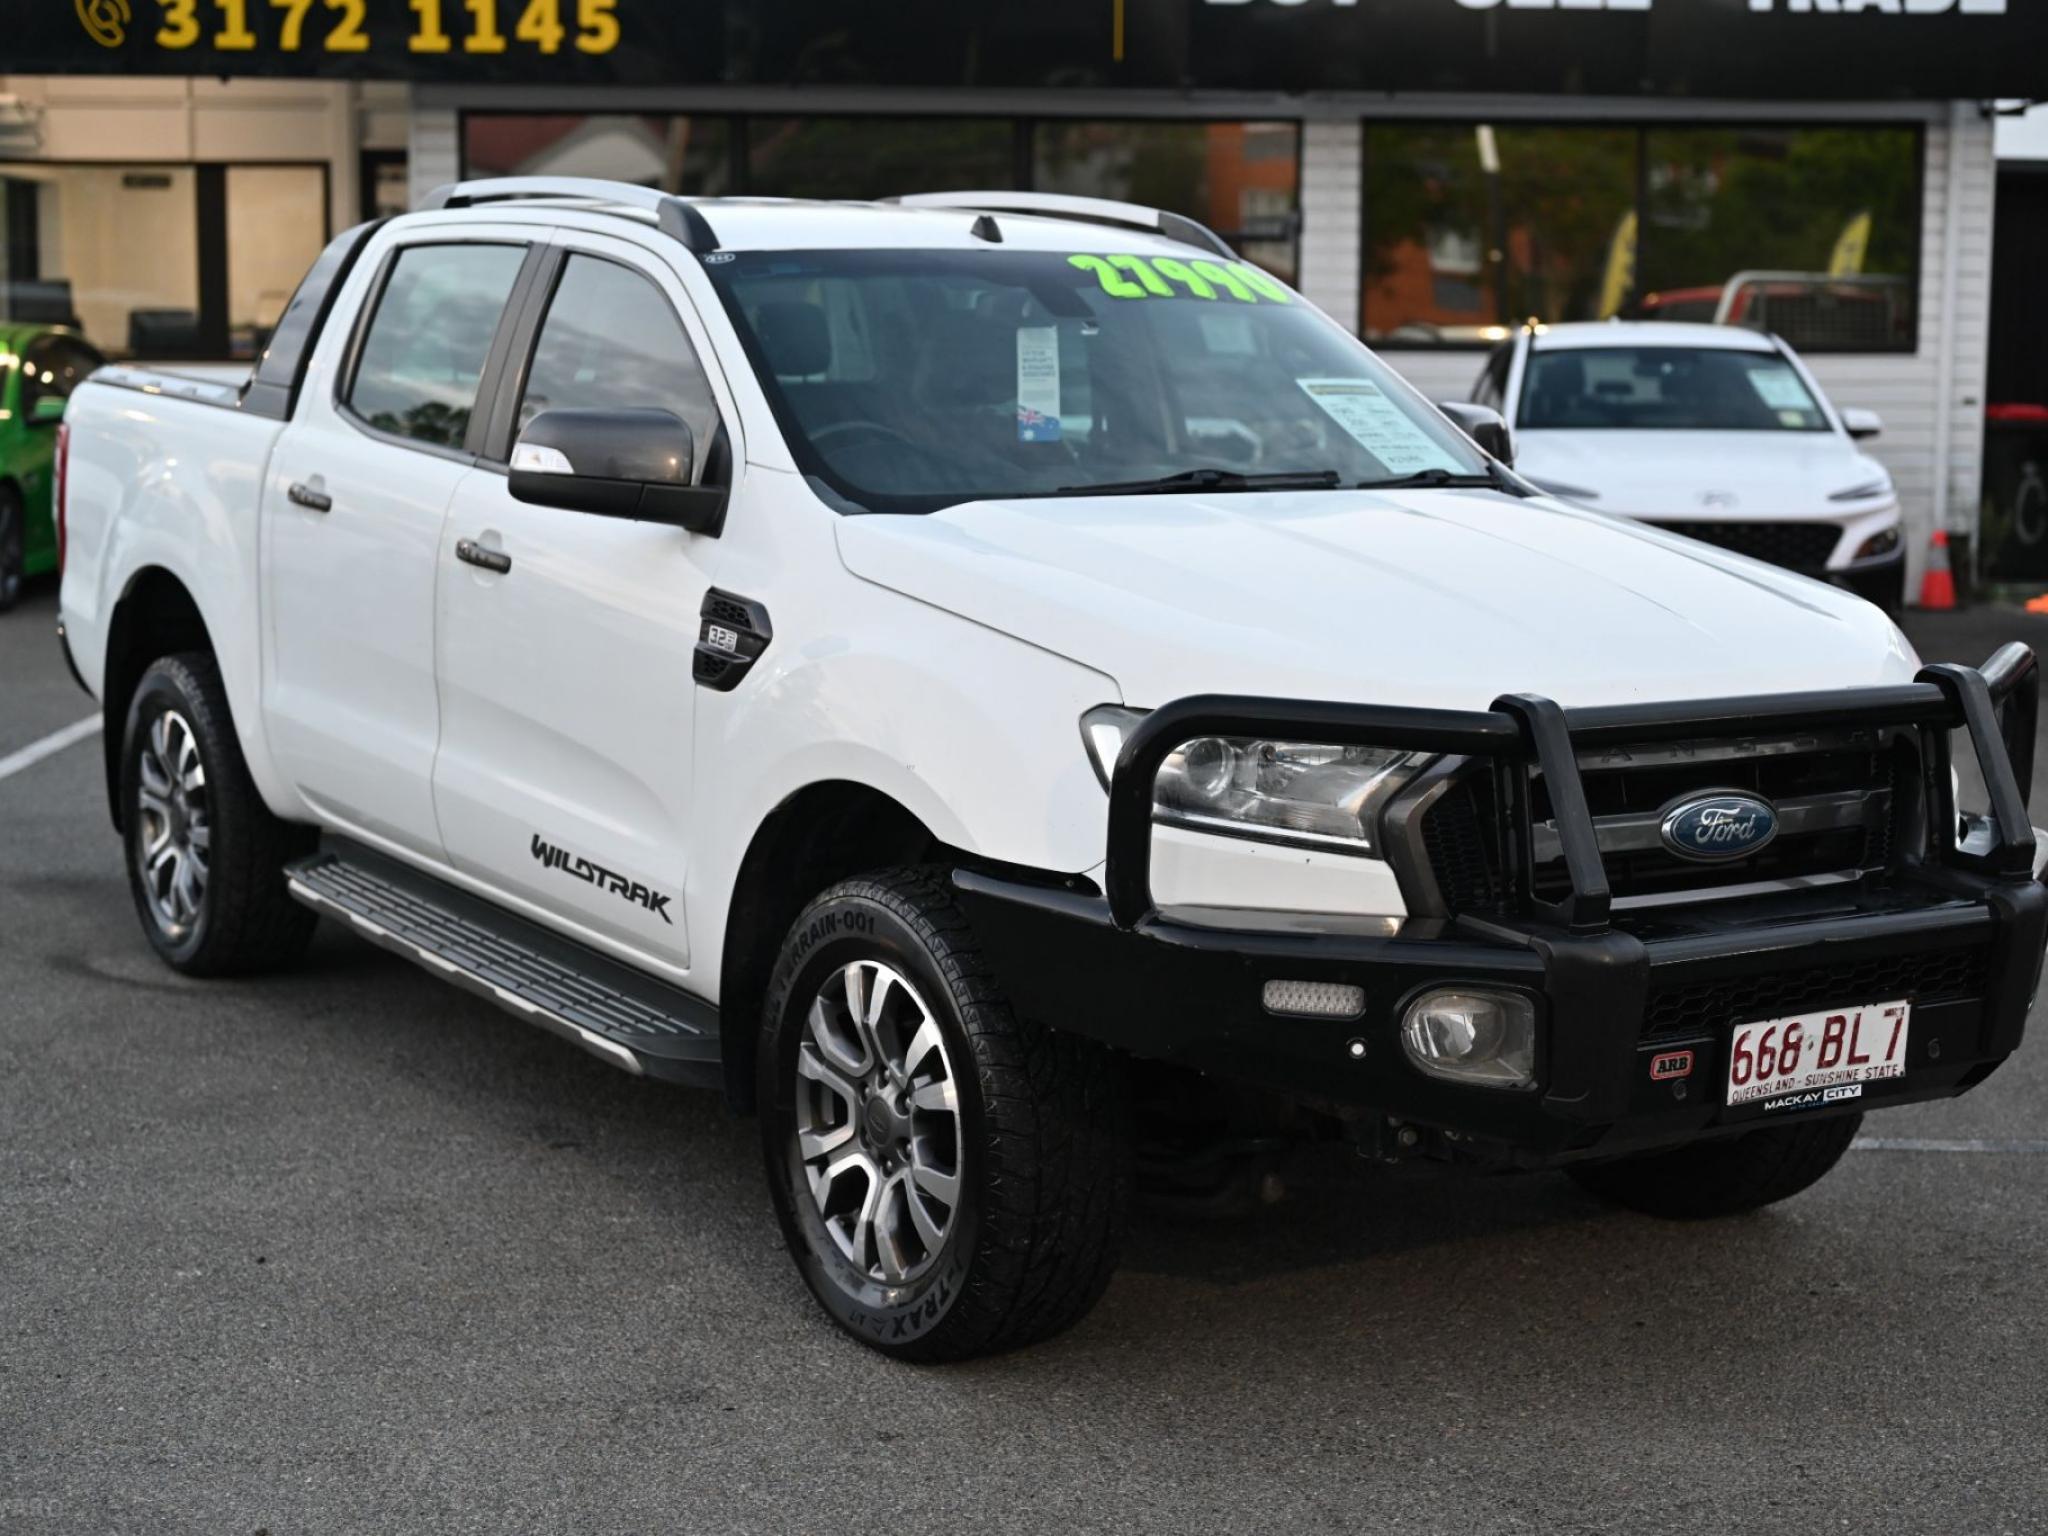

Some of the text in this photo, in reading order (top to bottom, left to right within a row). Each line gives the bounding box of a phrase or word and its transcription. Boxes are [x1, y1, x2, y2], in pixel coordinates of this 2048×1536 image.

[155, 0, 621, 54] 3172 1145
[1067, 254, 1291, 304] 27990
[1695, 807, 1757, 843] Ford
[531, 833, 673, 925] WILDTRAK
[1657, 1056, 1688, 1073] ARB
[1732, 1022, 1803, 1086] 668
[1732, 1078, 1796, 1104] QUEENSLAND
[1805, 1069, 1859, 1087] SUNSHINE
[1865, 1064, 1899, 1080] STATE
[1764, 1091, 1823, 1111] MACKAY
[1826, 1086, 1861, 1100] CITY
